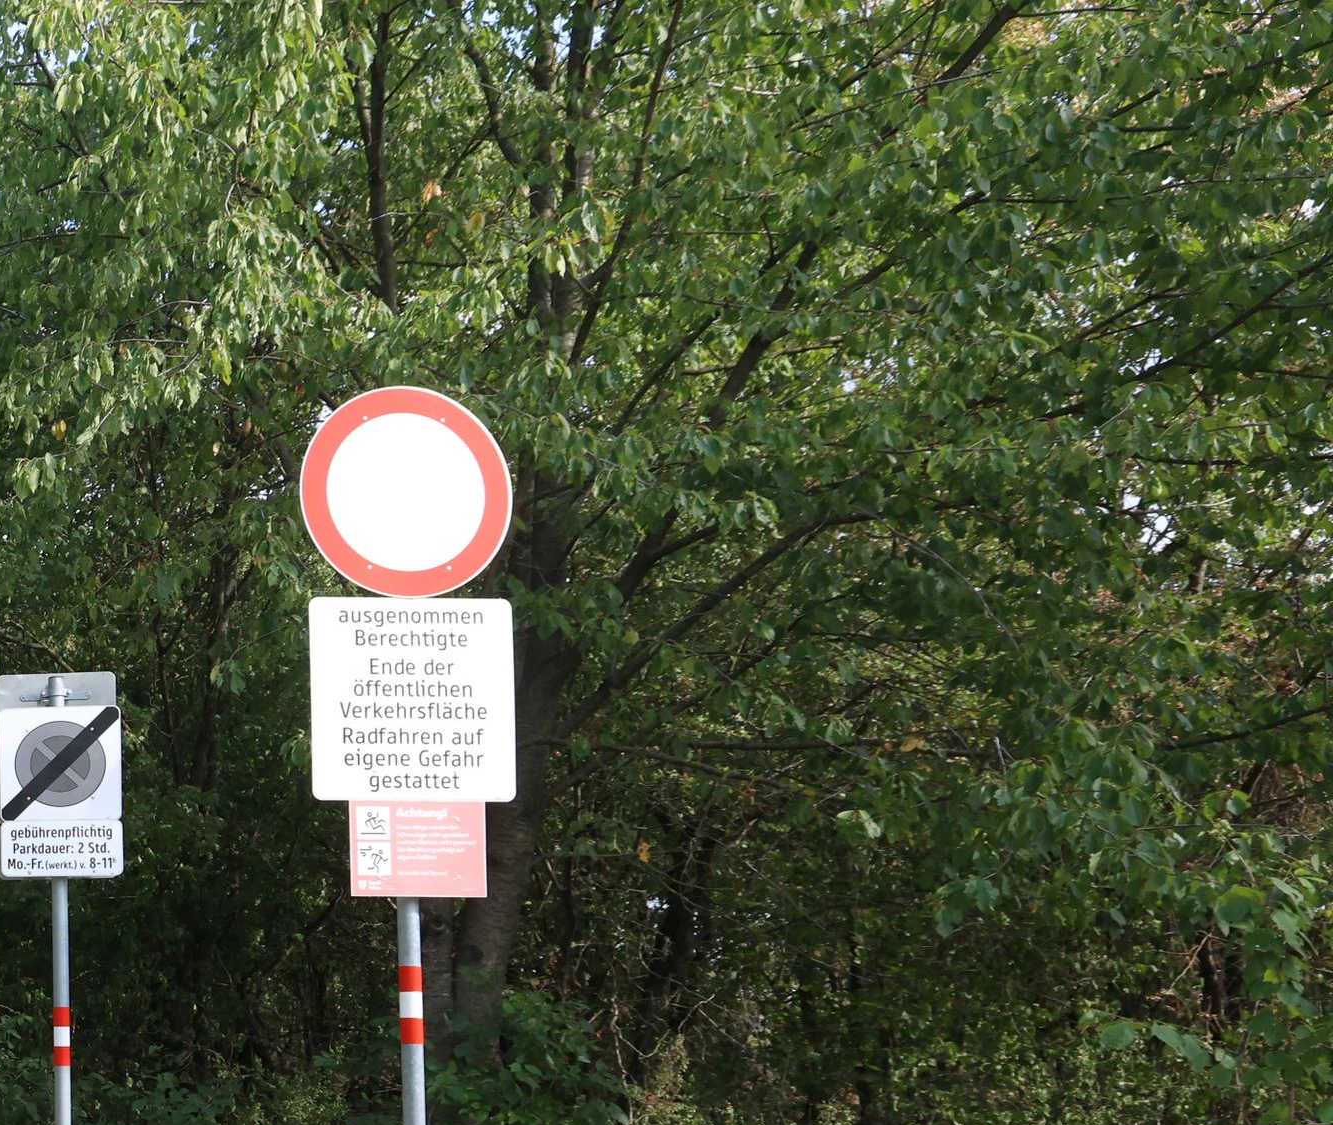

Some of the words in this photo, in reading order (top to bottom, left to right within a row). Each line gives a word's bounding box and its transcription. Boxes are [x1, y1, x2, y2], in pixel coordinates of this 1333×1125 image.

[338, 609, 484, 628] ausgenommen
[355, 629, 468, 651] Berechtigte
[369, 658, 416, 676] Ende
[424, 658, 455, 676] der
[353, 679, 473, 698] öffentlichen
[340, 701, 488, 720] Verkehrsfläche
[342, 727, 443, 745] Radfahren
[451, 728, 484, 746] auf
[344, 749, 411, 770] eigene
[418, 750, 484, 768] Gefahr
[369, 773, 460, 793] gestattet
[10, 826, 113, 840] gebührenpflichtig
[13, 843, 74, 854] Parkdauer:
[78, 842, 85, 854] 2
[88, 842, 111, 854] Std.
[7, 858, 44, 870] Mo.-Fr.
